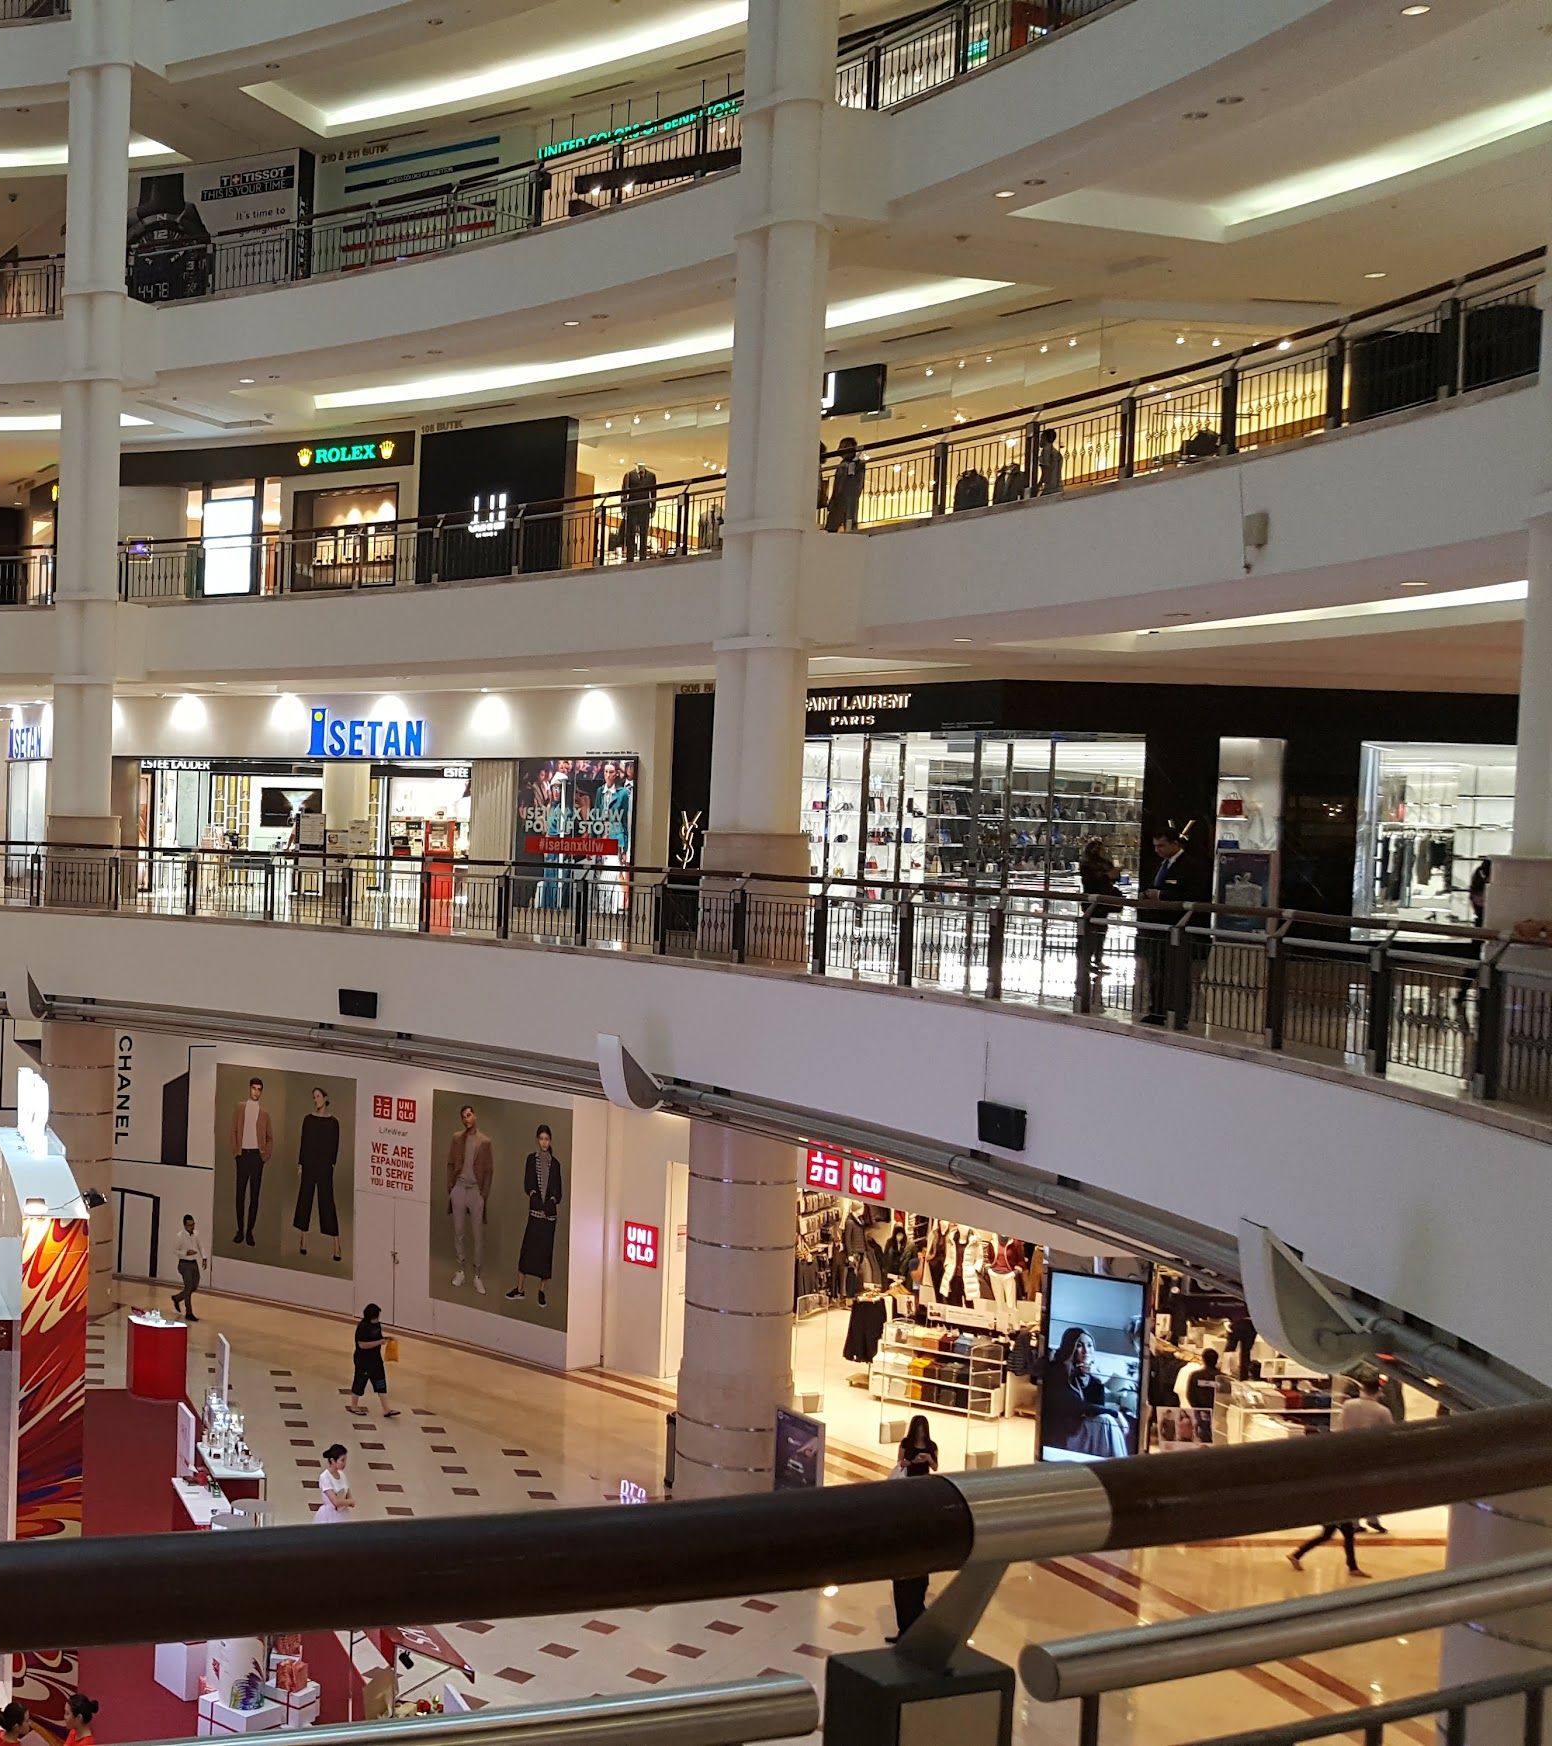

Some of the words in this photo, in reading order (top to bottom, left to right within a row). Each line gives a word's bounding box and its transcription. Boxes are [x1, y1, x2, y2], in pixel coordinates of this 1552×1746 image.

[242, 167, 286, 183] TISSOT
[203, 189, 224, 200] THIS
[225, 187, 234, 197] IS
[236, 183, 262, 195] YOUR
[265, 180, 286, 191] TIME
[236, 211, 250, 220] It's
[253, 209, 273, 218] time
[276, 207, 286, 215] to
[153, 229, 168, 240] 12
[315, 444, 376, 464] ROLEX
[843, 693, 912, 711] LAURENT
[830, 715, 876, 726] PARIS
[307, 708, 424, 757] ISETAN
[170, 760, 210, 770] LAUDER
[586, 808, 624, 821] KLFW
[115, 1035, 133, 1145] CHANEL
[378, 1126, 408, 1137] LifeWear
[371, 1142, 388, 1155] WE
[393, 1145, 414, 1159] ARE
[371, 1155, 414, 1170] EXPANDING
[371, 1166, 382, 1176] TO
[386, 1168, 414, 1182] SERVE
[371, 1177, 384, 1187] YOU
[852, 1173, 882, 1195] QLO
[626, 1226, 652, 1246] UNI
[626, 1243, 654, 1263] QLO
